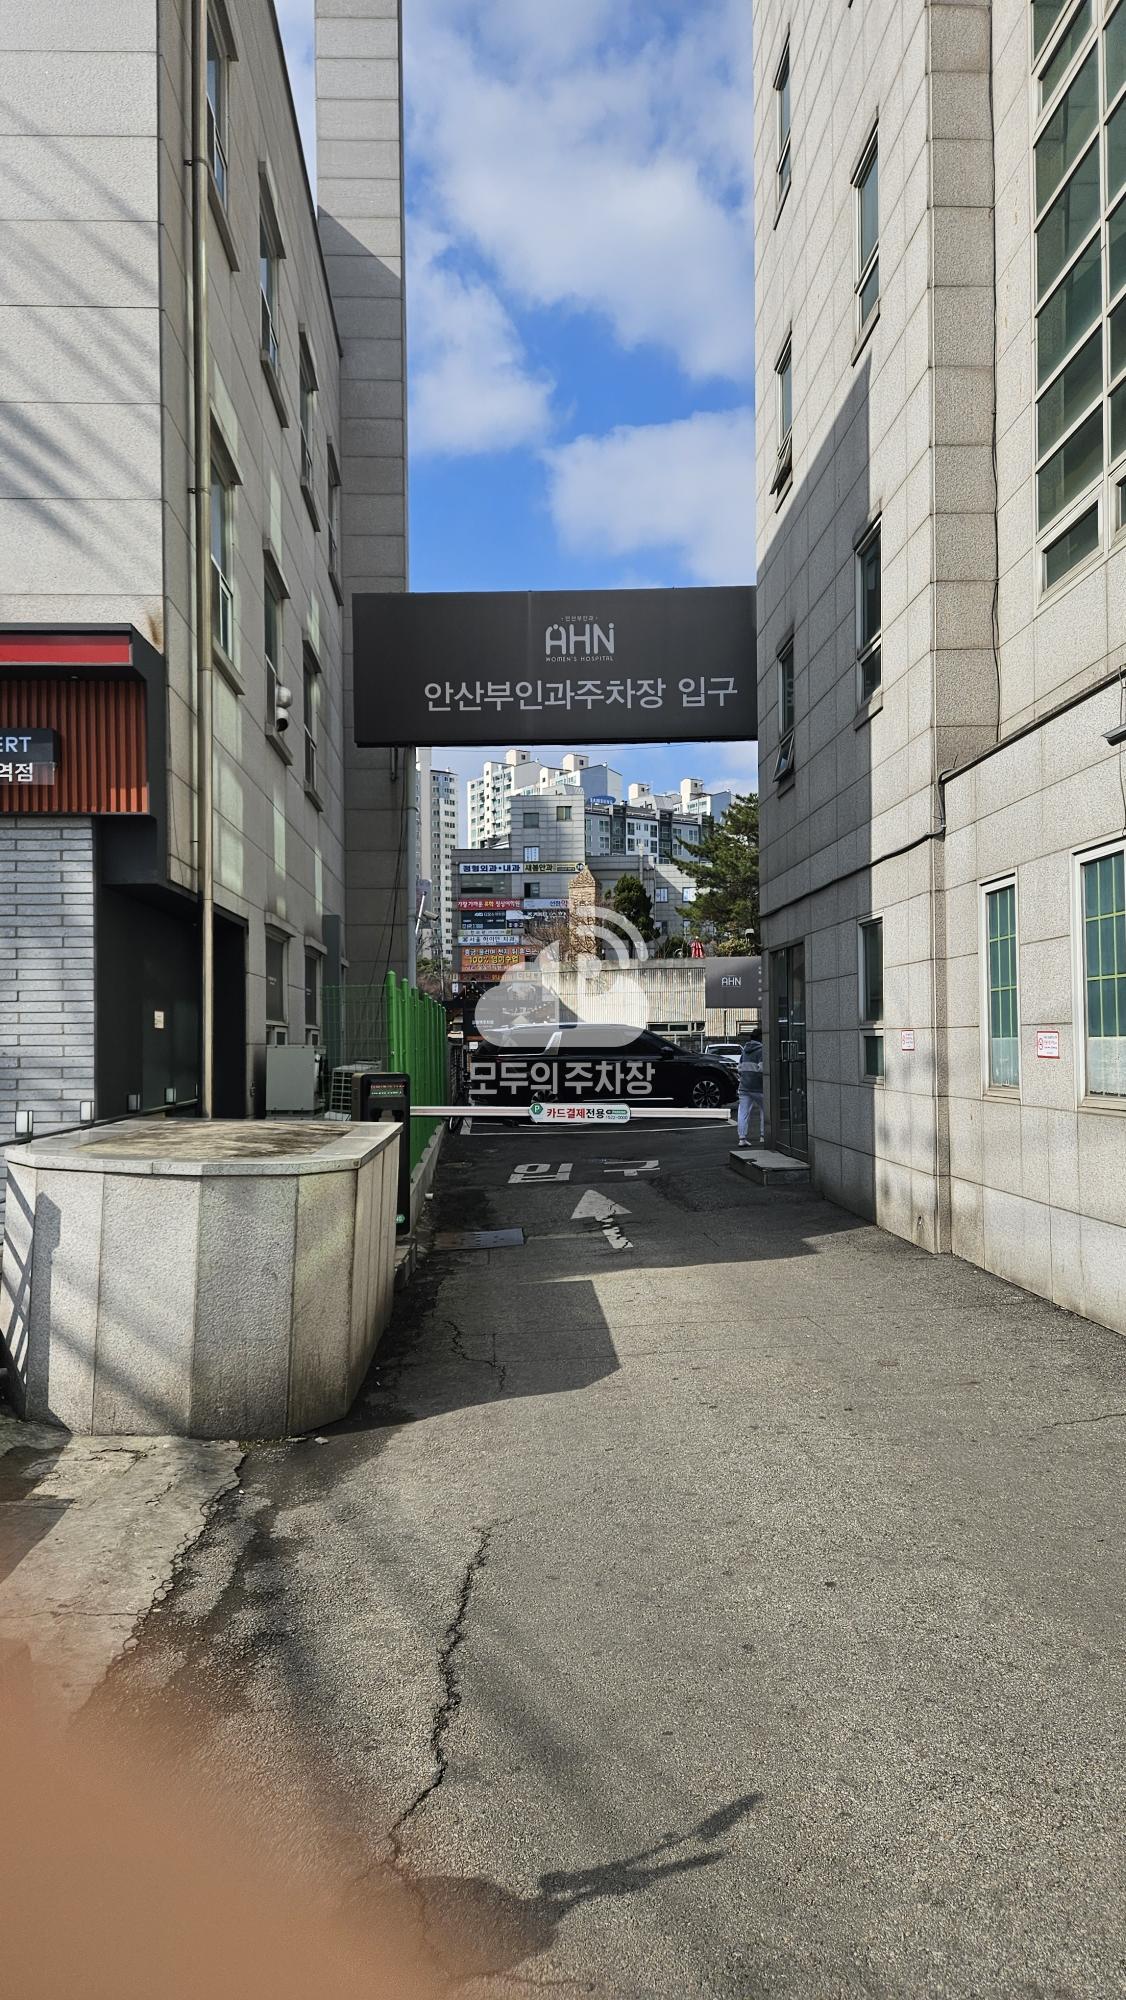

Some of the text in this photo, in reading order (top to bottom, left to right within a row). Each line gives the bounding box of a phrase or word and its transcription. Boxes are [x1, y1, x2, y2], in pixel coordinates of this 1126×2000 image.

[545, 622, 615, 655] AHN
[424, 676, 738, 712] 안산부인과주차장 입구
[721, 976, 742, 986] AHN
